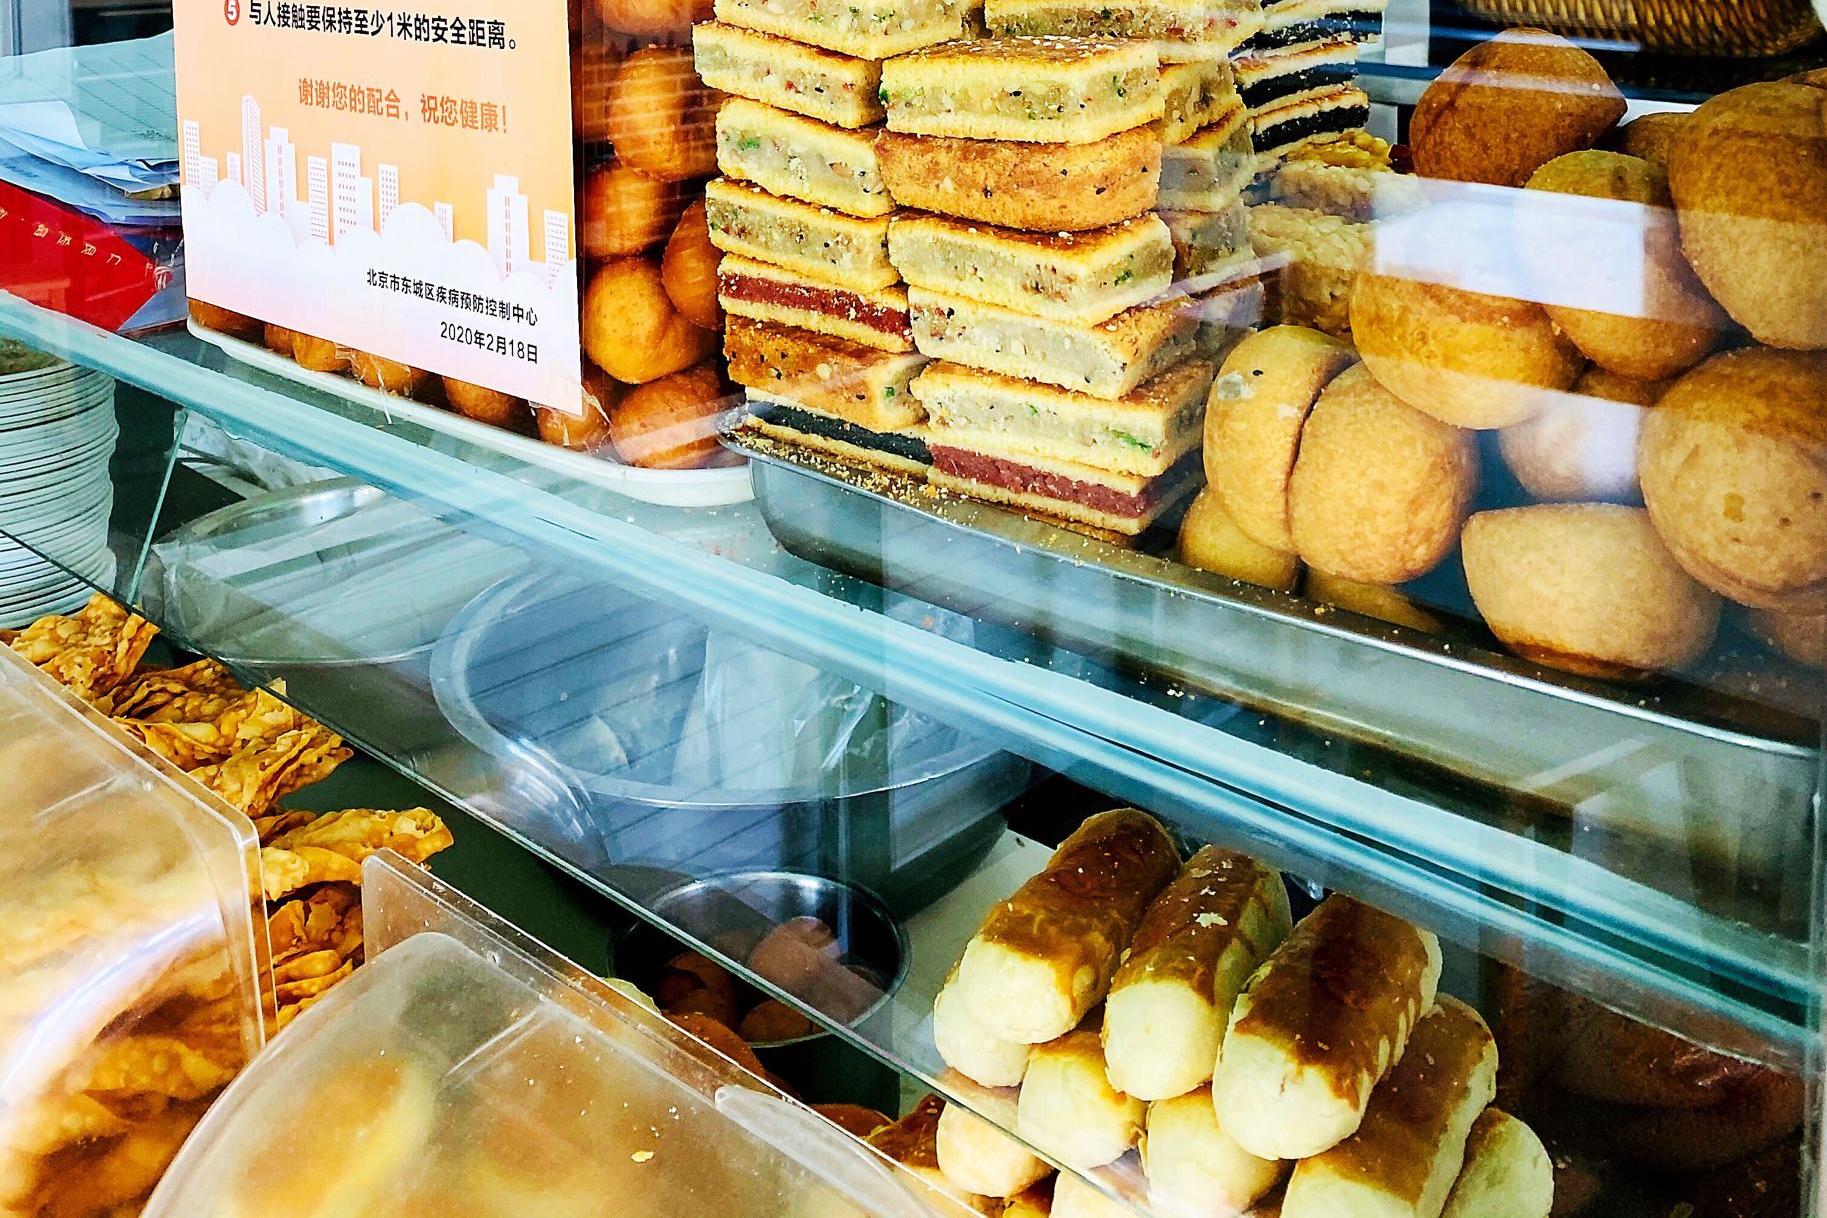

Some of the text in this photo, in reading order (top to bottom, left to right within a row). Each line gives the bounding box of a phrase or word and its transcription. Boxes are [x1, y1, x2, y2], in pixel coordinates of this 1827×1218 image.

[249, 0, 517, 50] 与人接触要保持至少1米的安全距离。
[299, 78, 507, 133] 谢谢您的配合，祝您健康！
[367, 268, 538, 326] 北京市东城区疾病预防控制中心
[440, 321, 538, 364] 2020年2月18日
